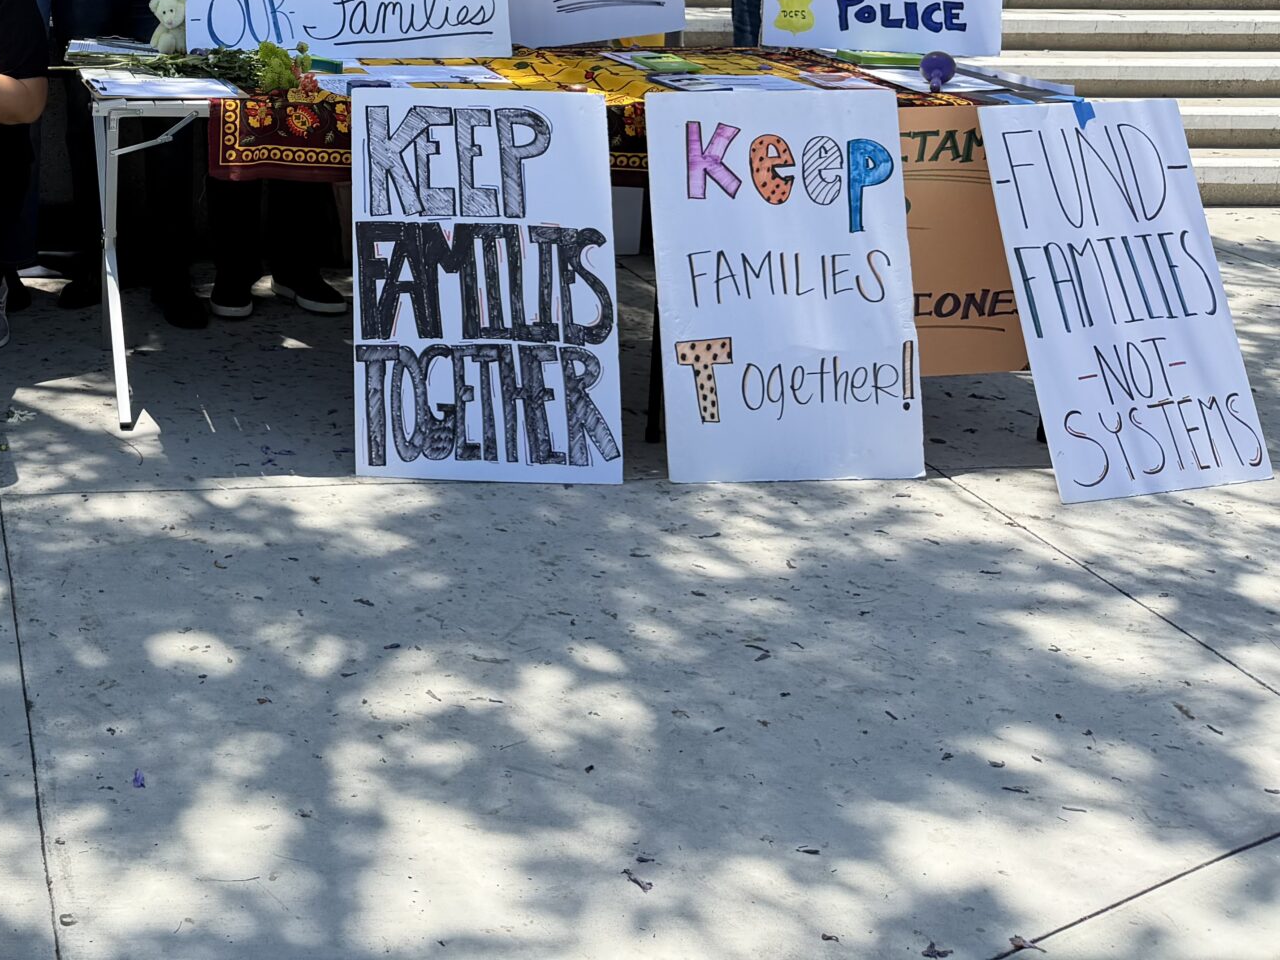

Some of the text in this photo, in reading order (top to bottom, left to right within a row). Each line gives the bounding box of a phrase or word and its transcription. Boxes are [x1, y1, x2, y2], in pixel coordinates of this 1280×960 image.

[780, 9, 807, 20] DCFS
[364, 104, 553, 219] KEEP
[355, 220, 615, 346] FAMILIES
[686, 249, 892, 308] FAMILIES
[1013, 230, 1219, 339] FAMILIES
[355, 342, 621, 468] TOGETHER
[1063, 392, 1264, 488] SYSTEMS
